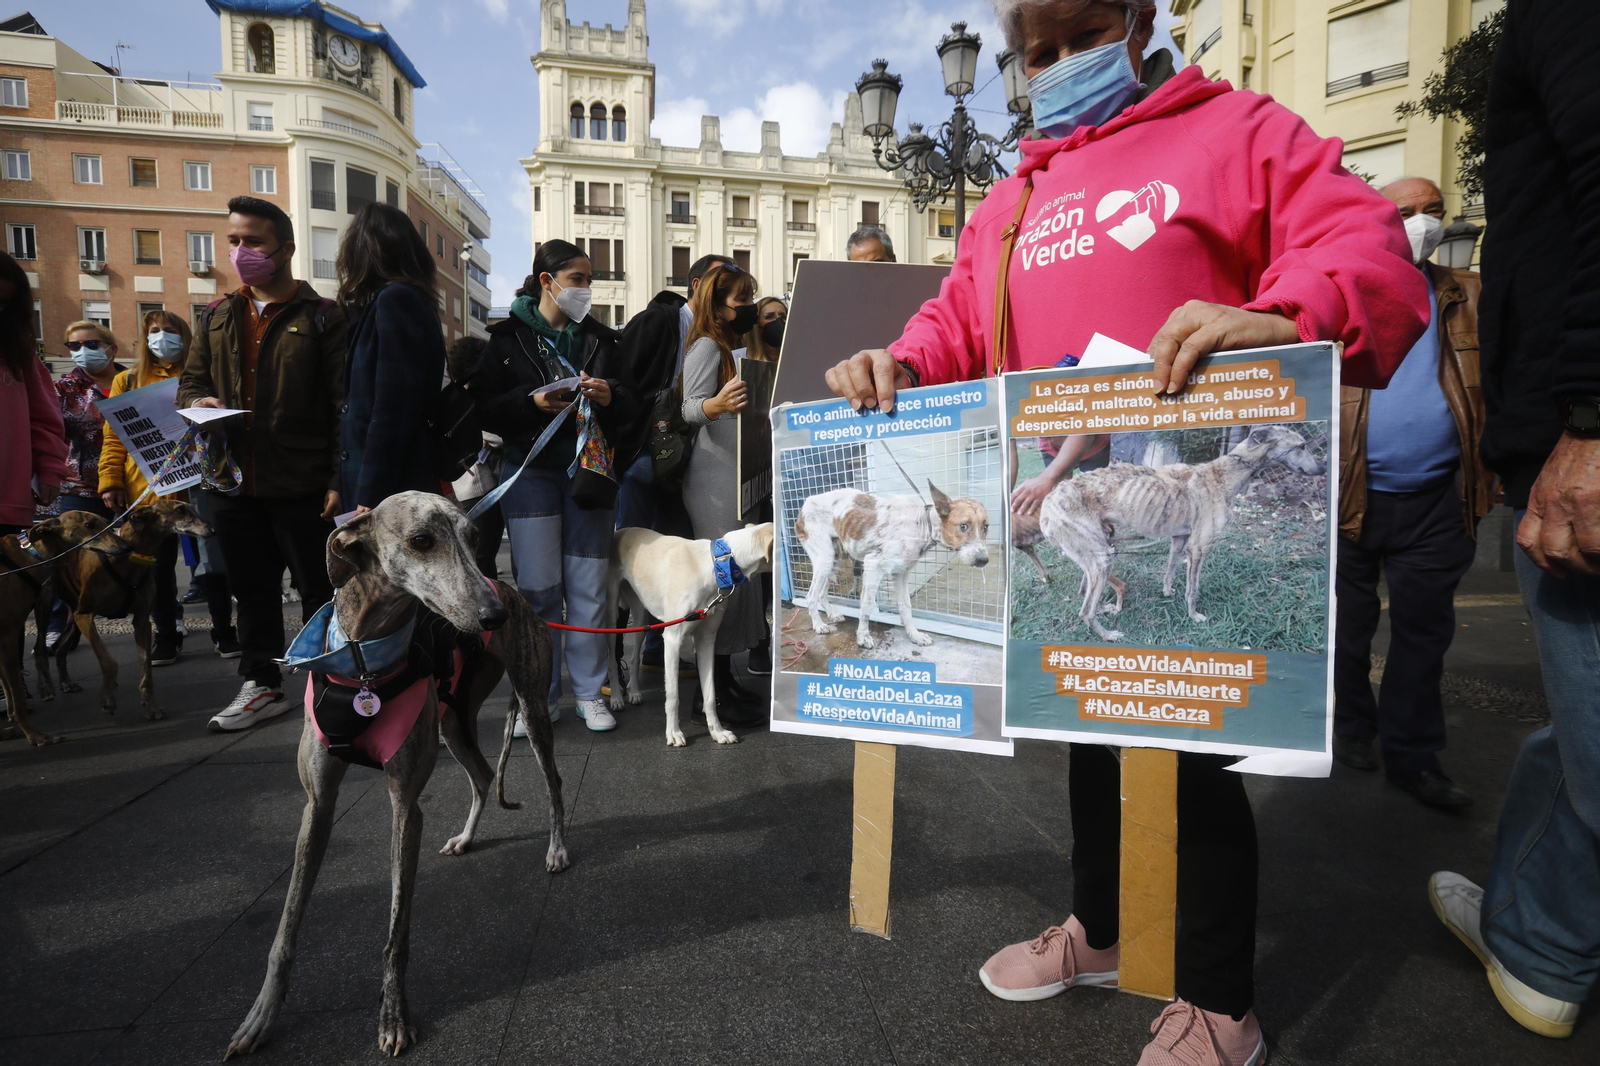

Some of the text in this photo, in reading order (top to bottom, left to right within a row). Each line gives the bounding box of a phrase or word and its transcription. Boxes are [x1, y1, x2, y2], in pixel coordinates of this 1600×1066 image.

[1025, 187, 1086, 228] Sanario animal
[1013, 204, 1084, 252] orazón
[1021, 228, 1095, 271] Verde
[1035, 367, 1274, 397] La Caza es sinón de muerte,
[790, 411, 822, 426] Todo
[925, 390, 983, 409] nuestro
[1024, 385, 1289, 414] crueldad, maltrato, tortura, abuso y
[113, 406, 139, 423] TODO
[123, 417, 156, 436] ANIMAL
[813, 413, 952, 442] respeto y protección
[1016, 402, 1296, 433] desprecio absoluto por la vida animal
[131, 430, 165, 449] MERECE
[140, 440, 177, 463] NUESTRO
[833, 663, 931, 684] #NoALaCaza
[1047, 651, 1254, 679] #RespetoVidaAnimal
[806, 682, 963, 709] #LaVerdadDeLaCaza
[1062, 674, 1242, 702] #LaCazaEsMuerte
[802, 702, 962, 731] #RespetoVidaAnimal
[1084, 698, 1211, 724] #NoALaCaza
